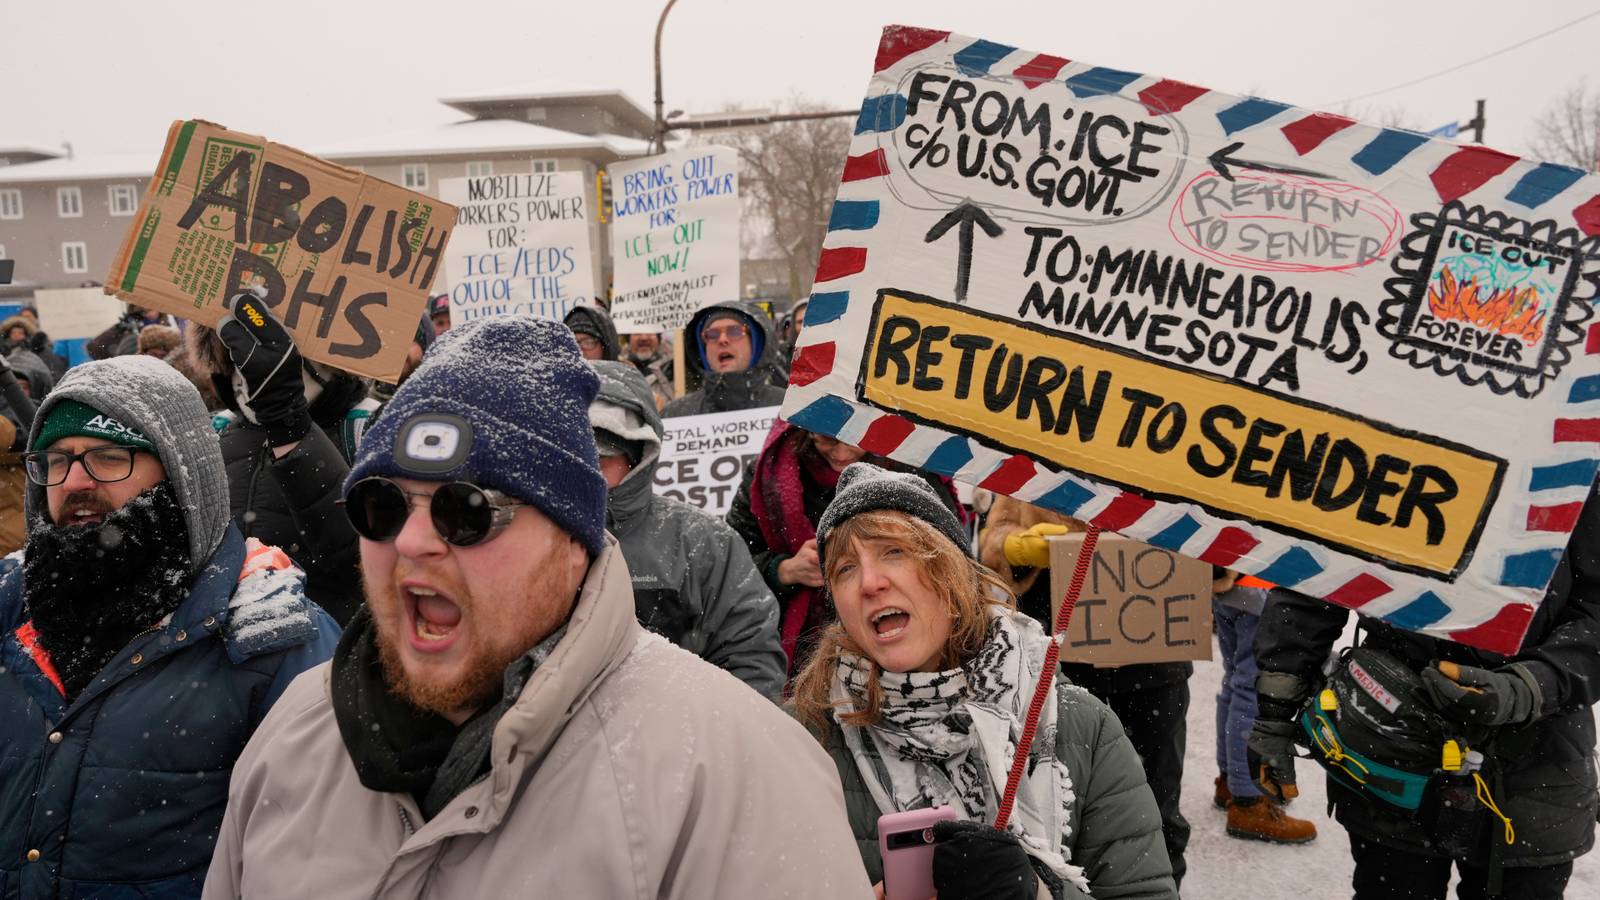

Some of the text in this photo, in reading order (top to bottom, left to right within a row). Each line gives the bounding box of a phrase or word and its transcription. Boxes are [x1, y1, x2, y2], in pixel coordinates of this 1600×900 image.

[624, 155, 714, 196] BRING OUT
[956, 134, 1021, 189] U.S.
[467, 174, 558, 201] MOBILIZE
[615, 173, 733, 217] WORKERS POWER
[1192, 178, 1360, 223] RETURN
[177, 150, 447, 290] ABOLISH
[527, 196, 583, 221] POWER
[192, 231, 207, 256] Prices
[488, 225, 526, 248] FOR:
[674, 219, 704, 245] OUT
[1184, 216, 1386, 267] TO SENDER
[222, 240, 234, 257] BUY
[648, 247, 689, 277] NOW!
[1448, 230, 1566, 275] ICE OUT
[187, 256, 198, 272] and
[193, 237, 225, 309] SAVE EVEN MORE!
[187, 268, 203, 295] Bundle
[528, 275, 568, 299] THE
[615, 274, 717, 304] INTERNATIONALIST
[222, 248, 388, 360] DHS
[243, 303, 265, 327] TOKO
[612, 301, 700, 320] REVOLUTIONARY
[633, 313, 694, 325] INTERNATIO
[1017, 281, 1300, 392] MINNESOTA
[1415, 314, 1523, 362] FOREVER
[86, 414, 144, 438] AFSC
[664, 427, 706, 441] STAL
[874, 314, 1459, 546] RETURN TO SENDER
[676, 434, 749, 452] DEMAND
[653, 458, 699, 486] CE
[631, 573, 657, 582] olumbia
[1091, 549, 1175, 595] NO
[1071, 594, 1196, 648] ICE
[1353, 668, 1384, 699] MEDIC
